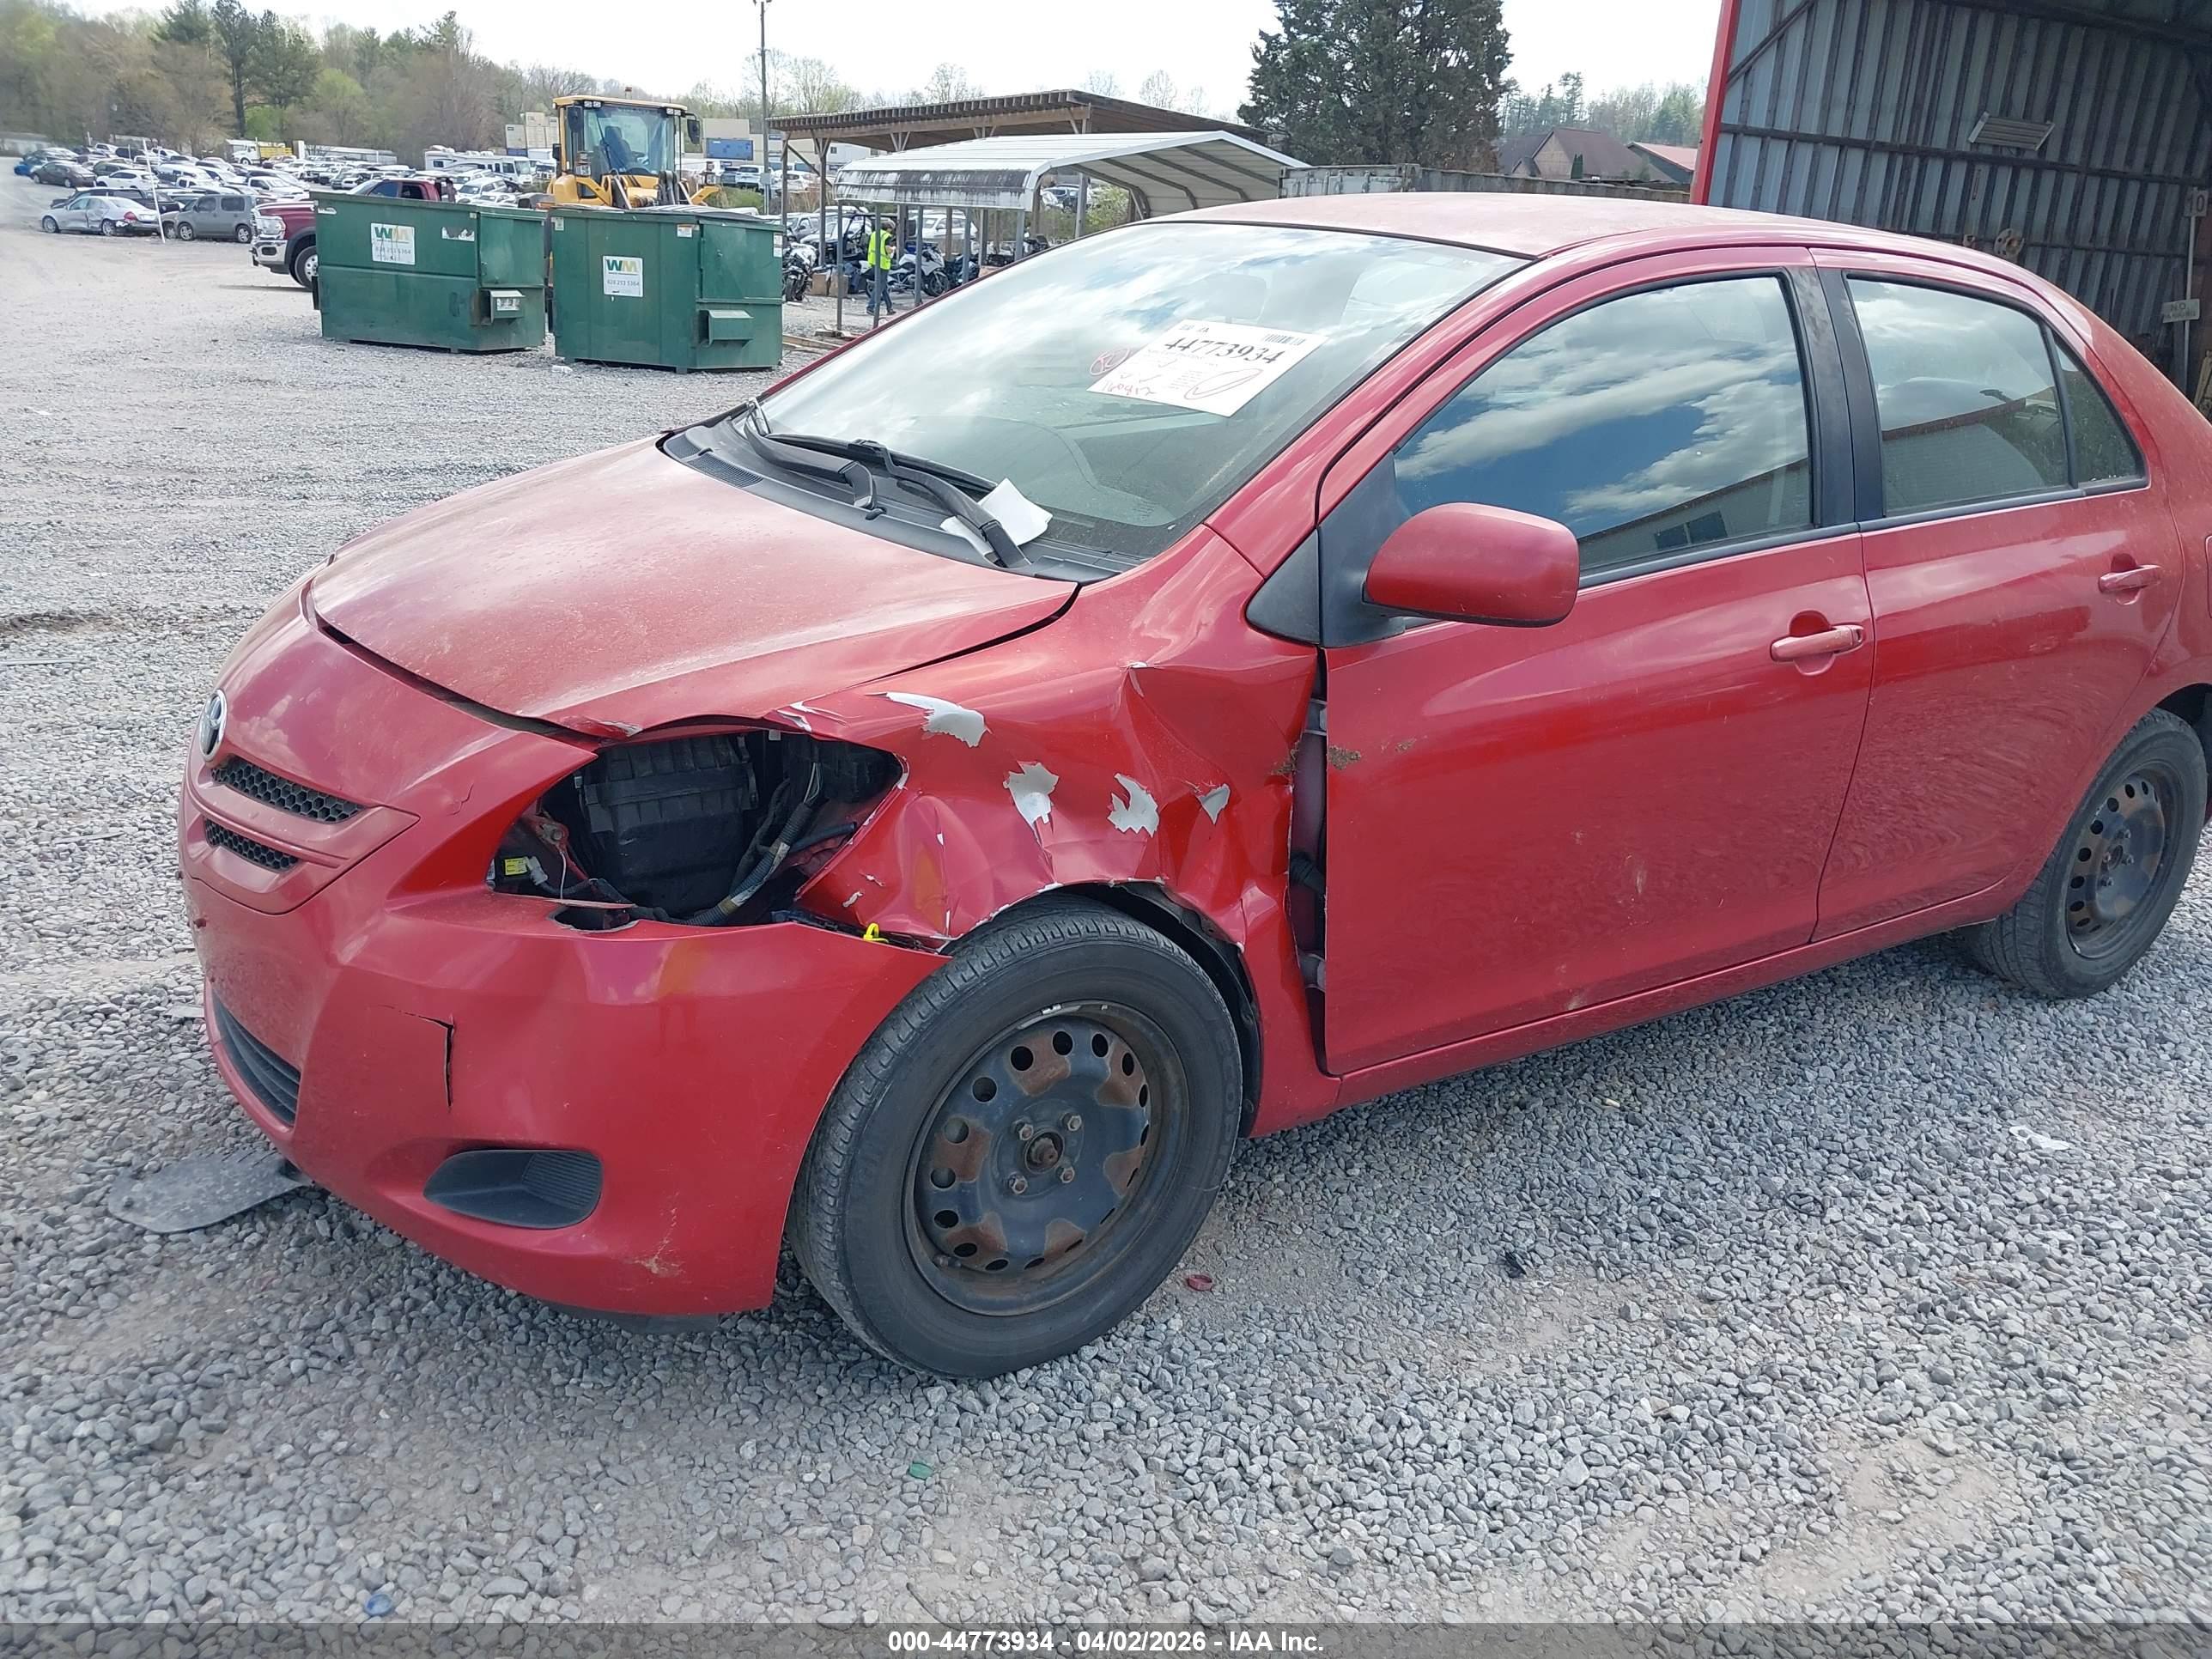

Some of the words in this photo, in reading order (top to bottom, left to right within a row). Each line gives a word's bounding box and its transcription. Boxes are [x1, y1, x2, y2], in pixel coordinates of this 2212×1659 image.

[2186, 194, 2205, 213] 10
[374, 227, 410, 240] WM
[606, 259, 638, 272] WM
[1164, 337, 1285, 364] 44773934
